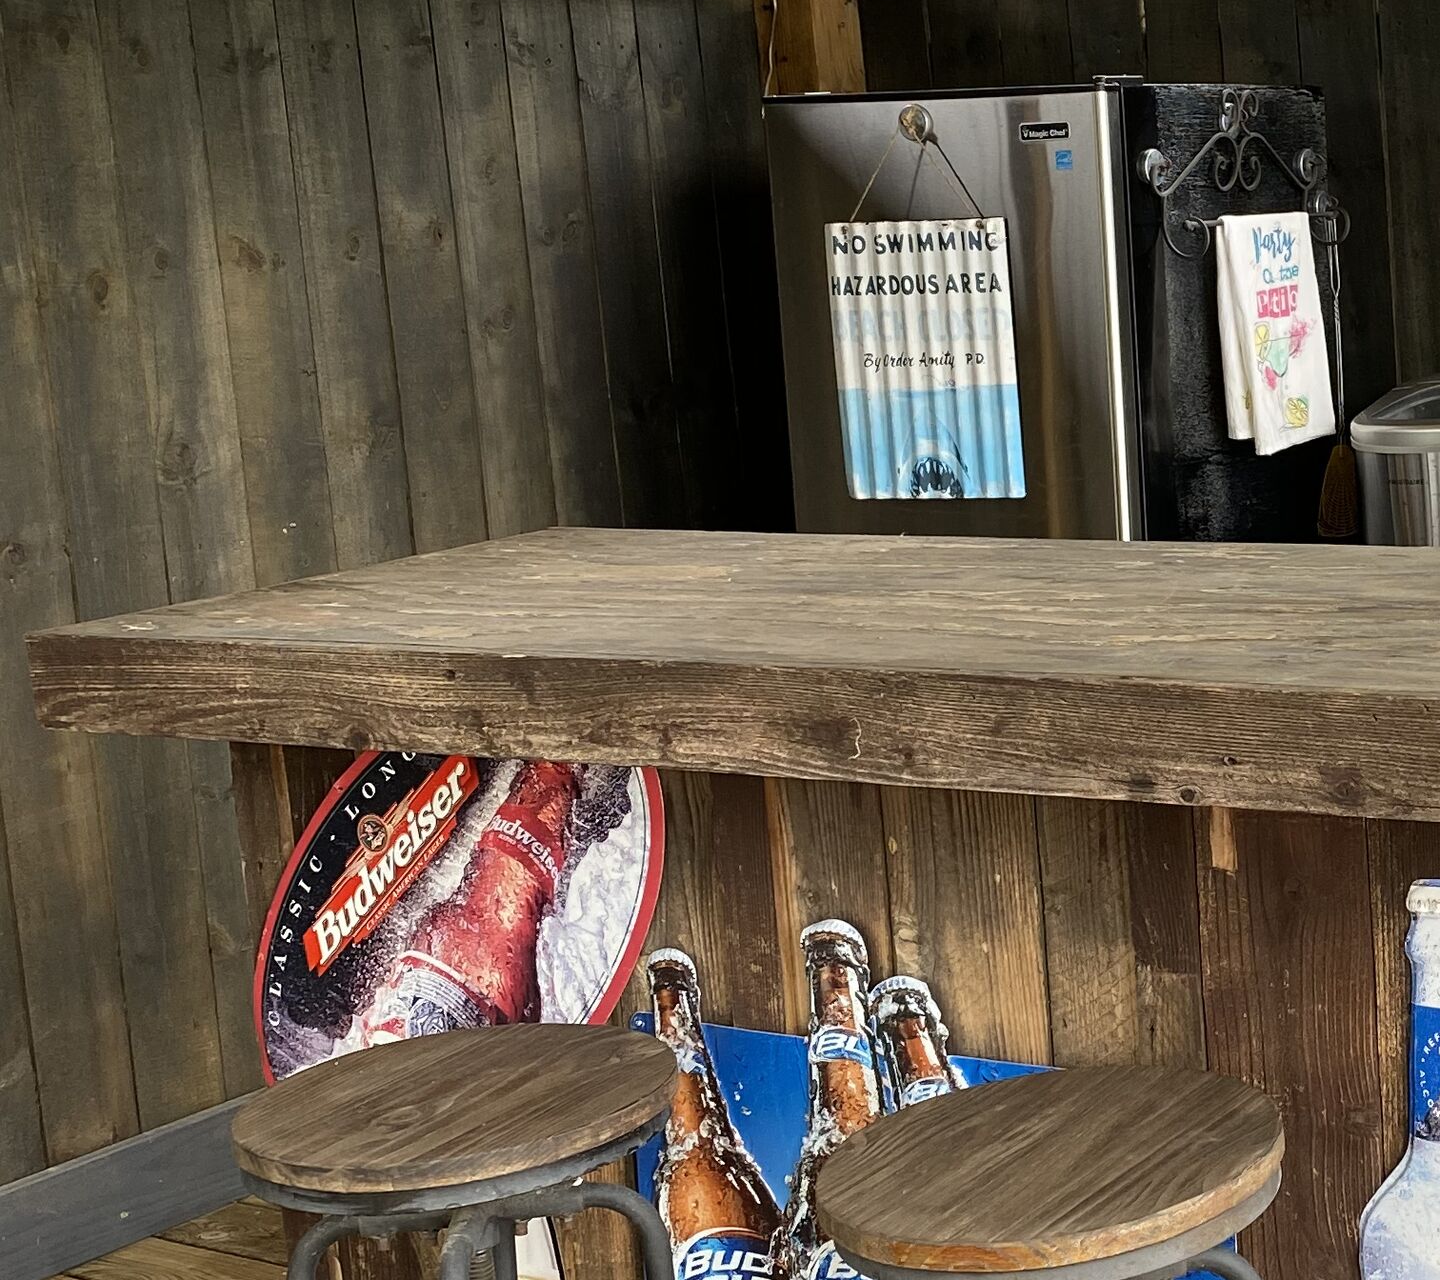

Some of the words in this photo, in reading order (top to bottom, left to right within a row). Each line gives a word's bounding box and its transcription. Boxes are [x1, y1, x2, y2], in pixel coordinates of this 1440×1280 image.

[832, 234, 867, 255] NO
[874, 230, 1000, 255] SWIMMING
[1252, 226, 1296, 264] Party
[831, 273, 940, 296] HAZARDOUS
[945, 272, 1003, 295] AREA
[863, 352, 882, 373] By
[883, 351, 916, 368] Order
[918, 350, 956, 370] Amity
[311, 761, 465, 965] Budweiser
[490, 814, 559, 879] udweise
[269, 855, 323, 1027] CLASSIC
[684, 1248, 773, 1280] BUD
